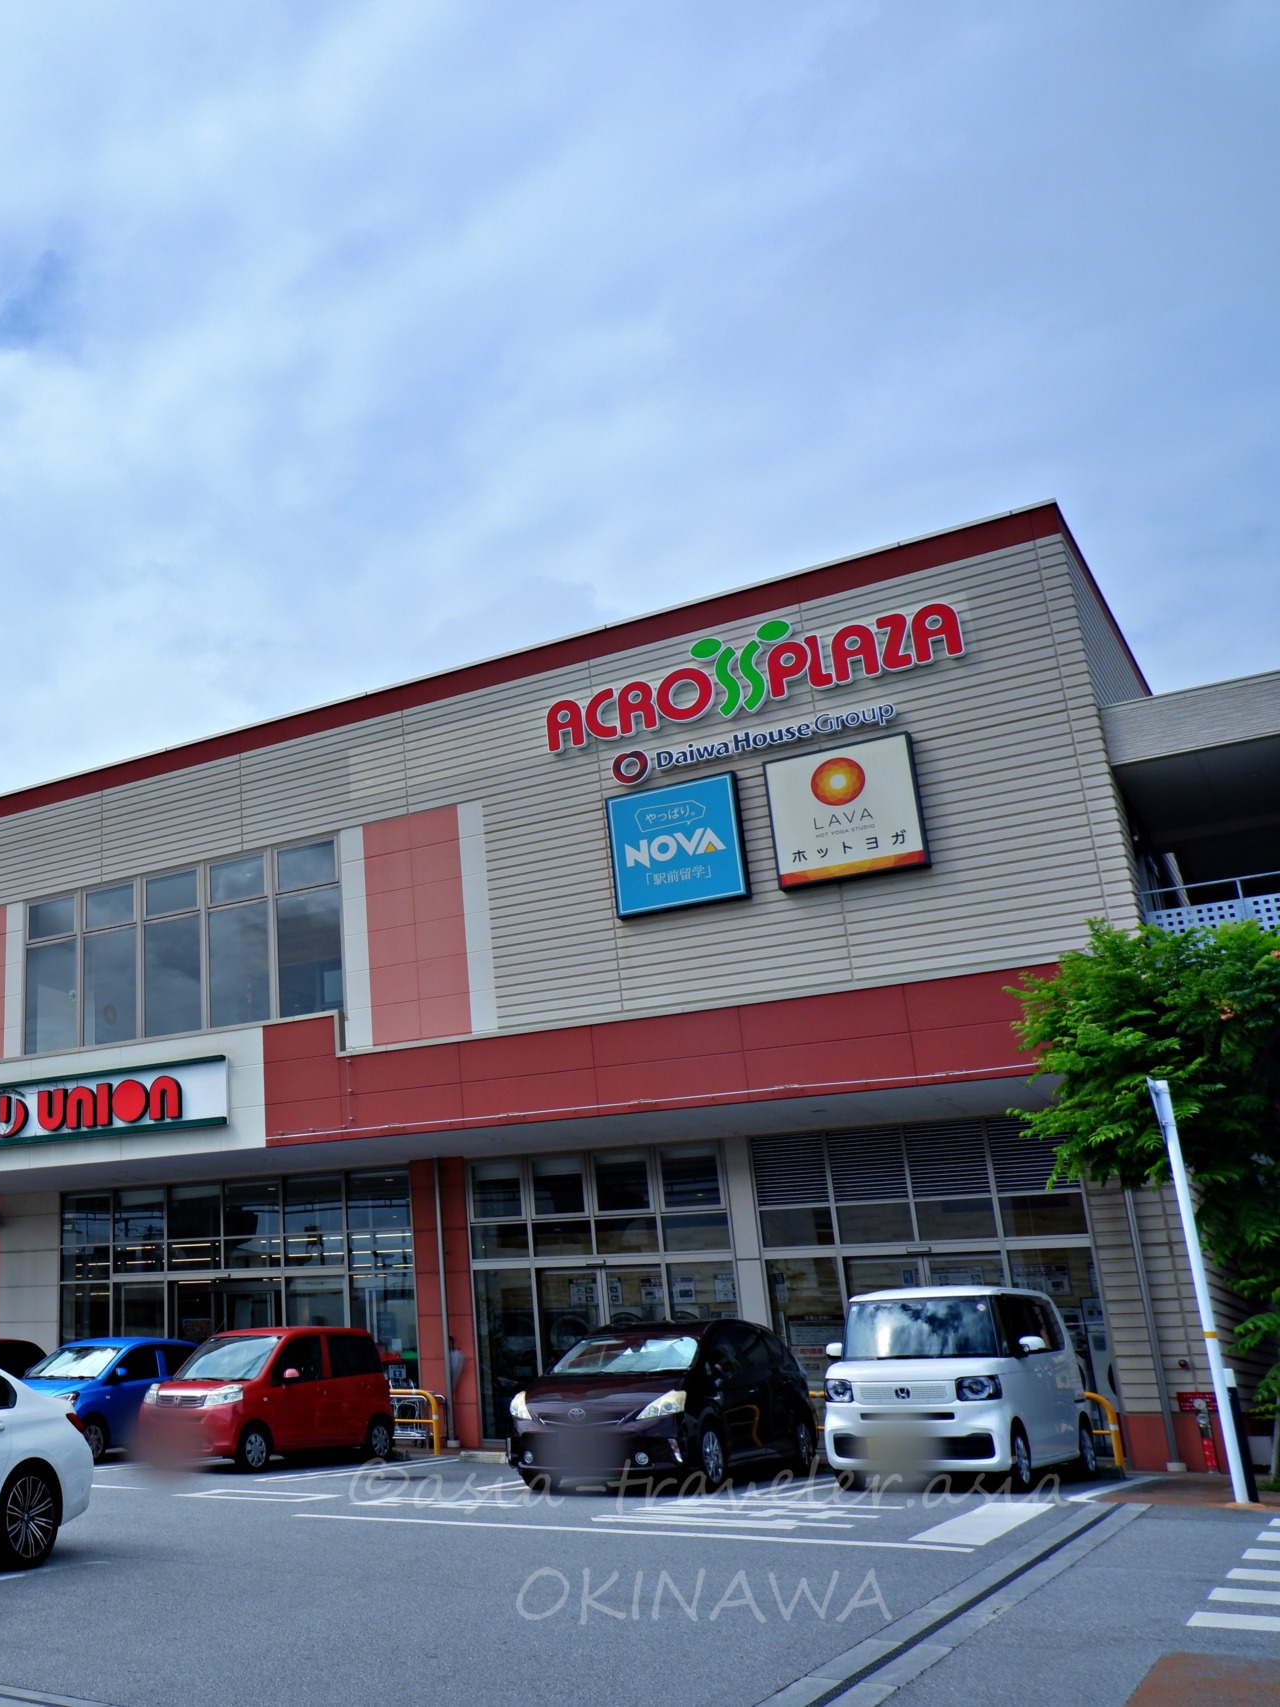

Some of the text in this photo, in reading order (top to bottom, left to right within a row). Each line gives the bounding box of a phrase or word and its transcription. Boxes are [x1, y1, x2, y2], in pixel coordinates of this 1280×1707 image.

[655, 702, 895, 769] Daiwa House Group
[813, 808, 874, 830] LAVA
[830, 828, 849, 836] YOGA
[851, 823, 876, 833] STUDIO
[624, 827, 727, 868] NOVA
[792, 829, 907, 863] ホットヨガ
[36, 1075, 183, 1132] UNION
